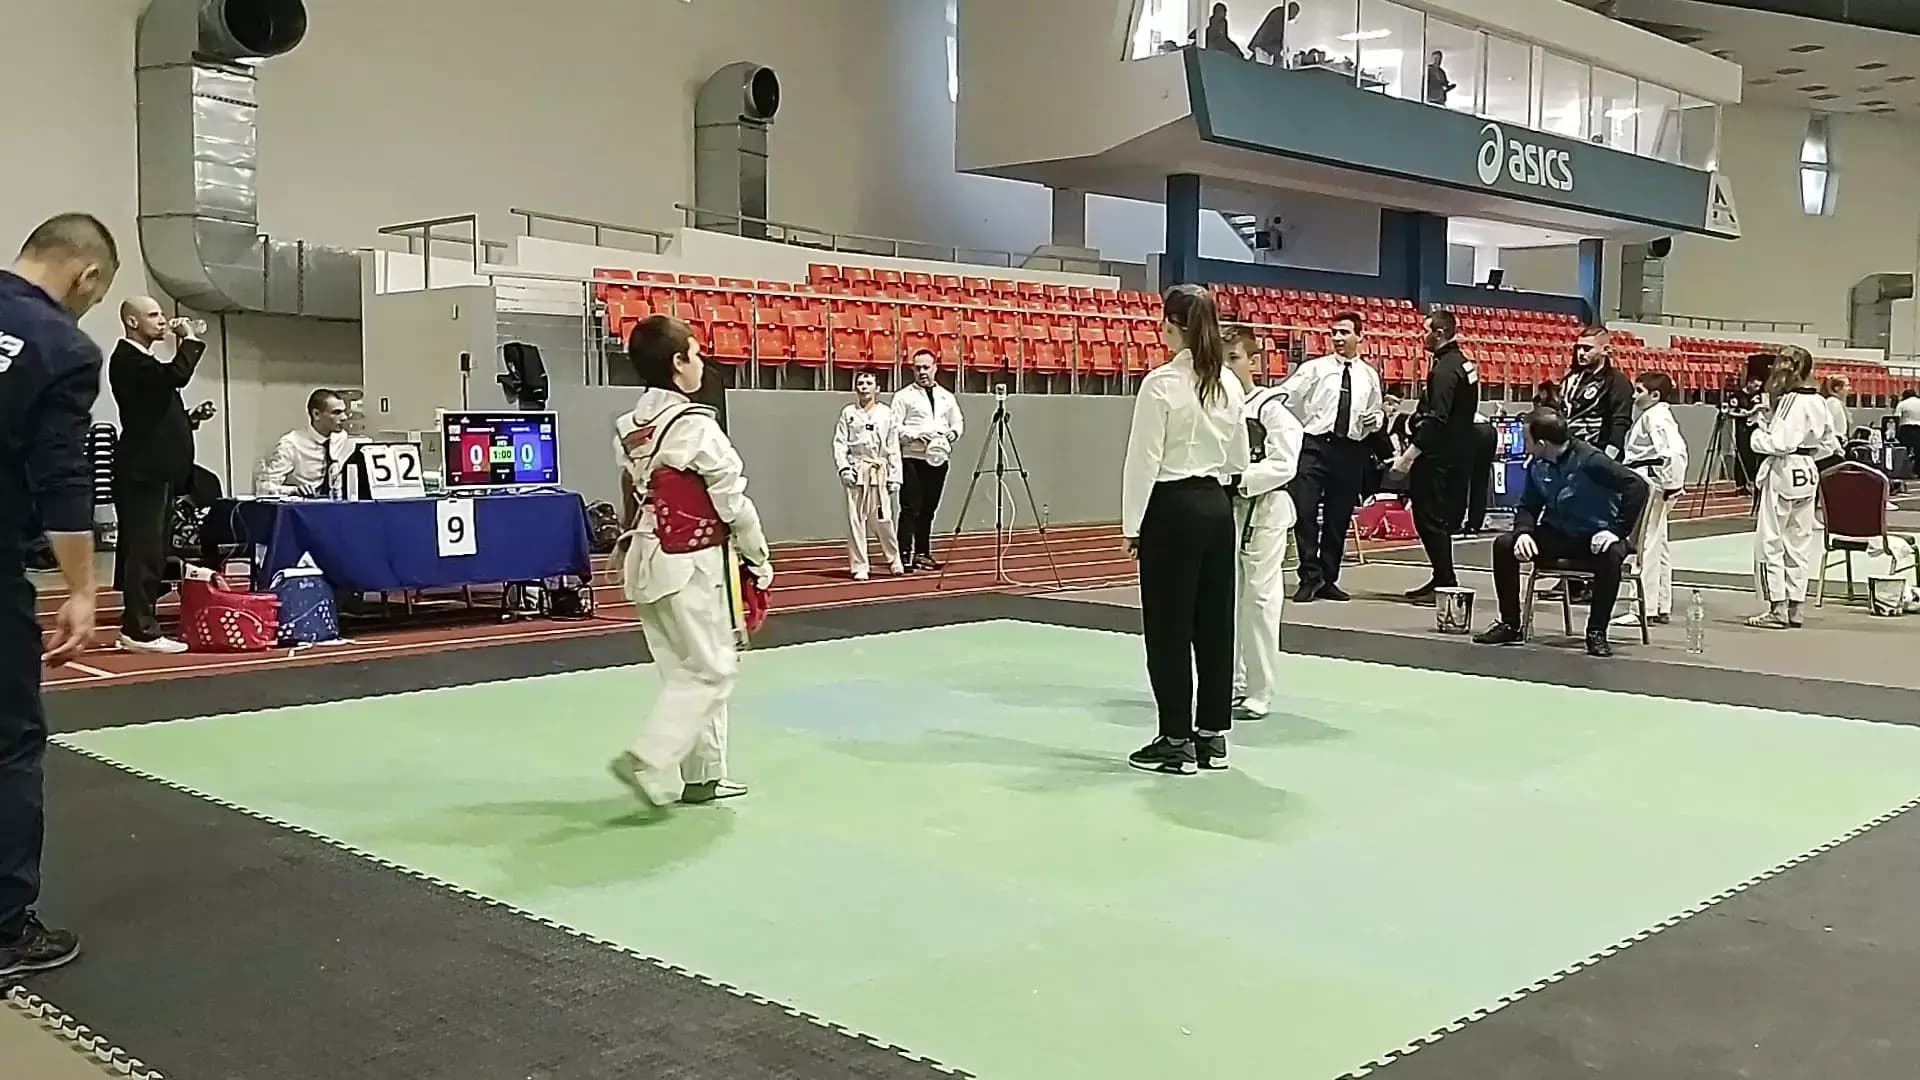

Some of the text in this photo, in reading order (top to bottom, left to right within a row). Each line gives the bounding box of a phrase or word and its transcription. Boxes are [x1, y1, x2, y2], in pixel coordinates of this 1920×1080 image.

[1508, 138, 1574, 192] asics
[470, 444, 483, 464] 0
[493, 450, 512, 459] 1:00
[521, 443, 534, 463] 0
[371, 453, 419, 481] 52
[448, 516, 464, 543] 9
